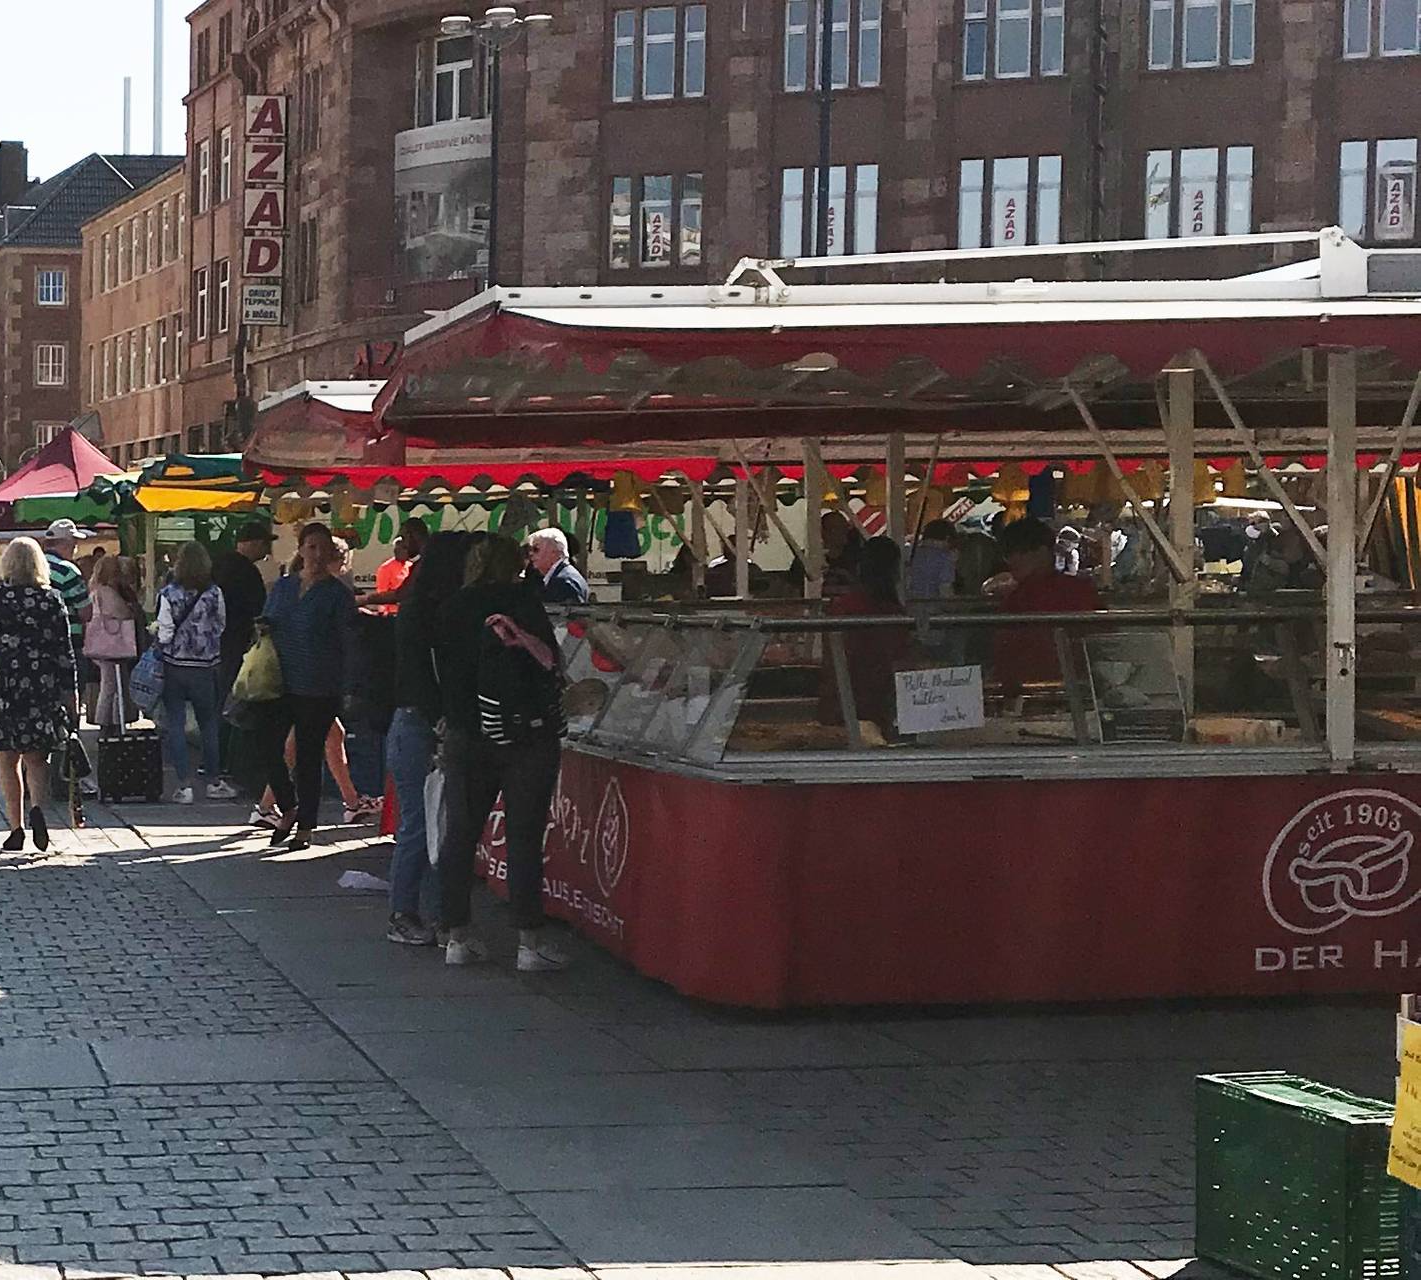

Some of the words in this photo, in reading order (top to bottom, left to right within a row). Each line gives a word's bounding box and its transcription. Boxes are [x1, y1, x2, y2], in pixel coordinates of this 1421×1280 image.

[246, 98, 284, 274] AZAD
[1389, 182, 1401, 226] AZAD
[1004, 198, 1016, 240] AZAD
[1192, 189, 1203, 233] AZAD
[650, 213, 662, 255] AZAD
[1298, 811, 1335, 857] seit
[1343, 803, 1402, 832] 1903
[1254, 945, 1345, 972] DER
[1374, 940, 1421, 969] H
